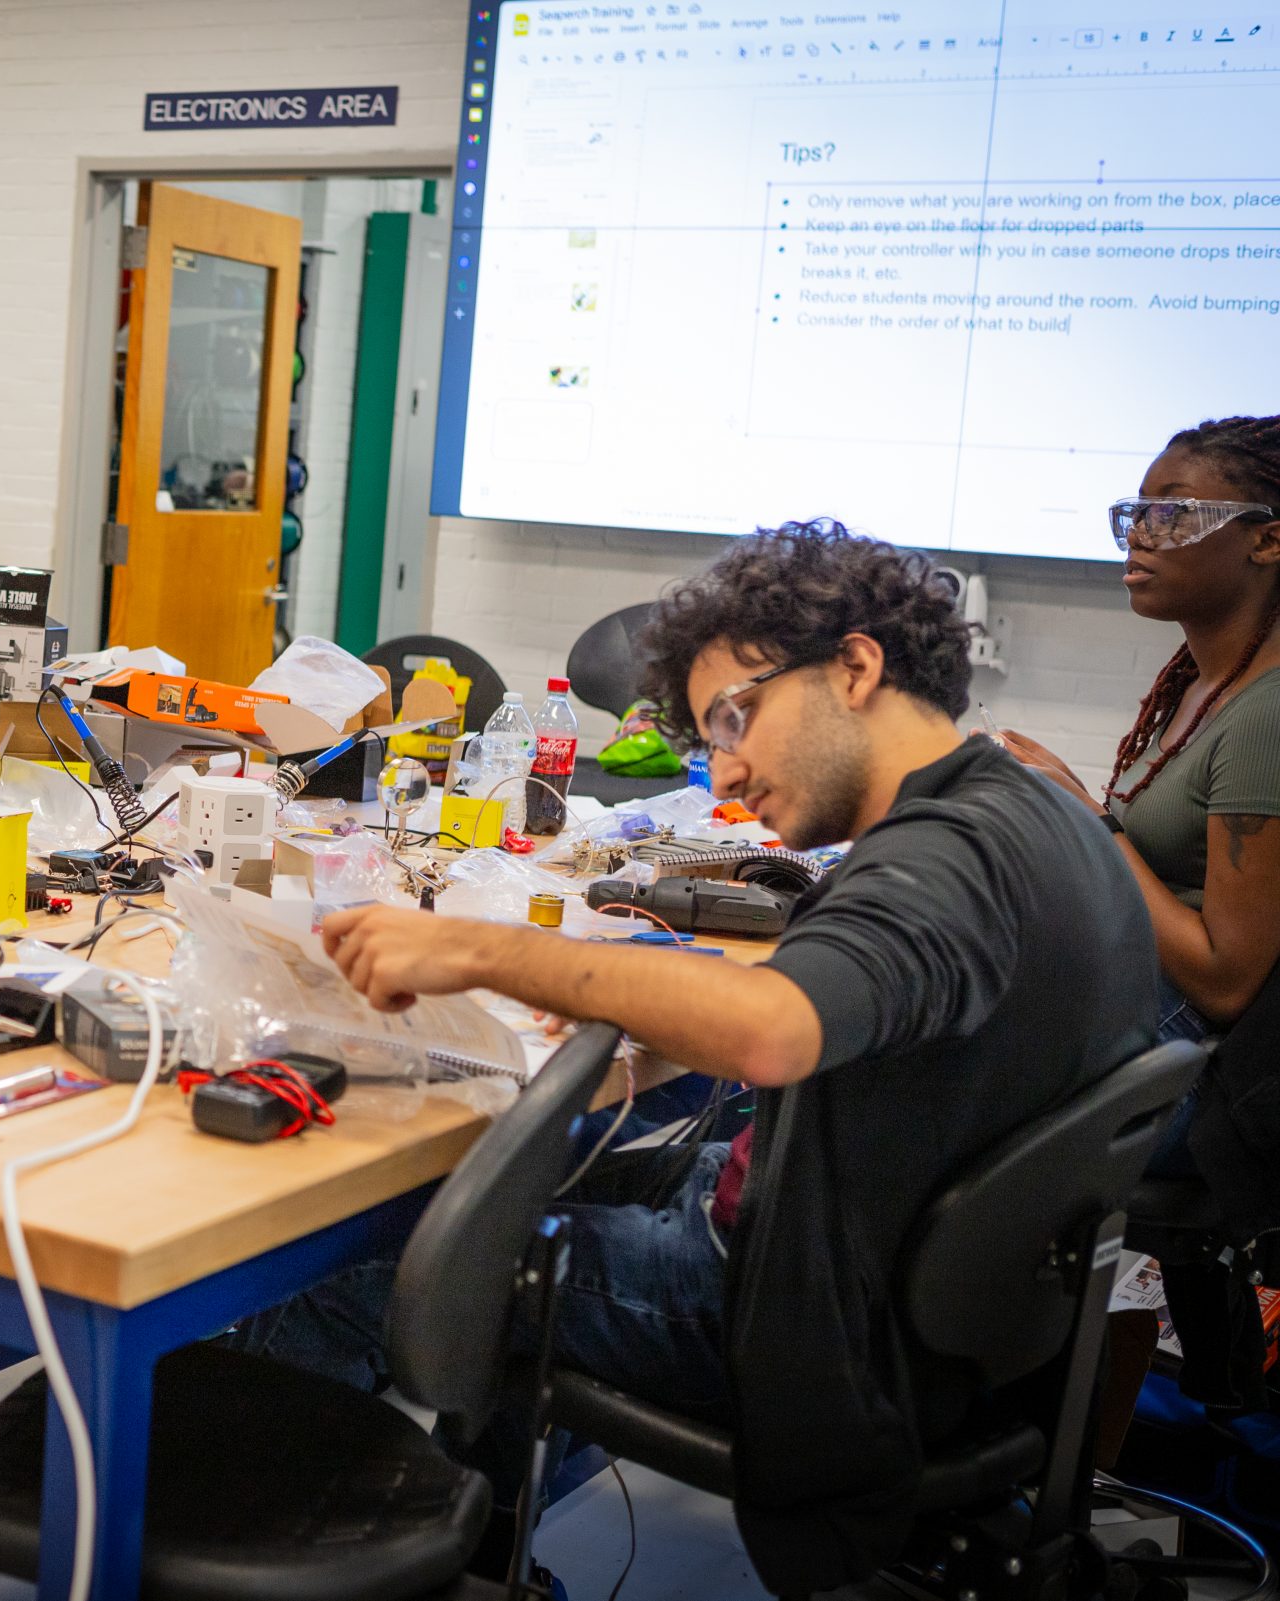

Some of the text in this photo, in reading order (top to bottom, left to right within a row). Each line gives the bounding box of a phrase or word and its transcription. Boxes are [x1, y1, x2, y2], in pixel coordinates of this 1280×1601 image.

[538, 5, 634, 21] Seaperch Training
[620, 23, 646, 33] Insert
[654, 21, 688, 32] Format
[730, 18, 768, 30] Arrange
[779, 15, 804, 26] Tools
[814, 13, 866, 26] Extensions
[877, 11, 902, 23] Help
[149, 94, 389, 123] ELECTRONICS AREA
[779, 142, 837, 167] Tips?
[807, 191, 1280, 211] Only remove what you are working on from the box, place
[805, 216, 1145, 236] Keep an eye on the floor for dropped parts
[806, 241, 839, 257] Take
[844, 244, 877, 259] your
[882, 242, 954, 257] controller
[959, 243, 992, 257] with
[997, 244, 1026, 261] you
[1031, 243, 1046, 258] in
[1051, 245, 1091, 259] case
[1096, 245, 1175, 259] someone
[1180, 244, 1230, 262] drops
[801, 265, 852, 280] breaks
[874, 266, 903, 280] etc.
[799, 288, 1280, 315] Reduce students moving around the room. Avoid bumping
[797, 311, 1068, 333] Consider the order of what to build
[7, 590, 38, 606] TABLE
[8, 603, 33, 611] UNIVERSAL
